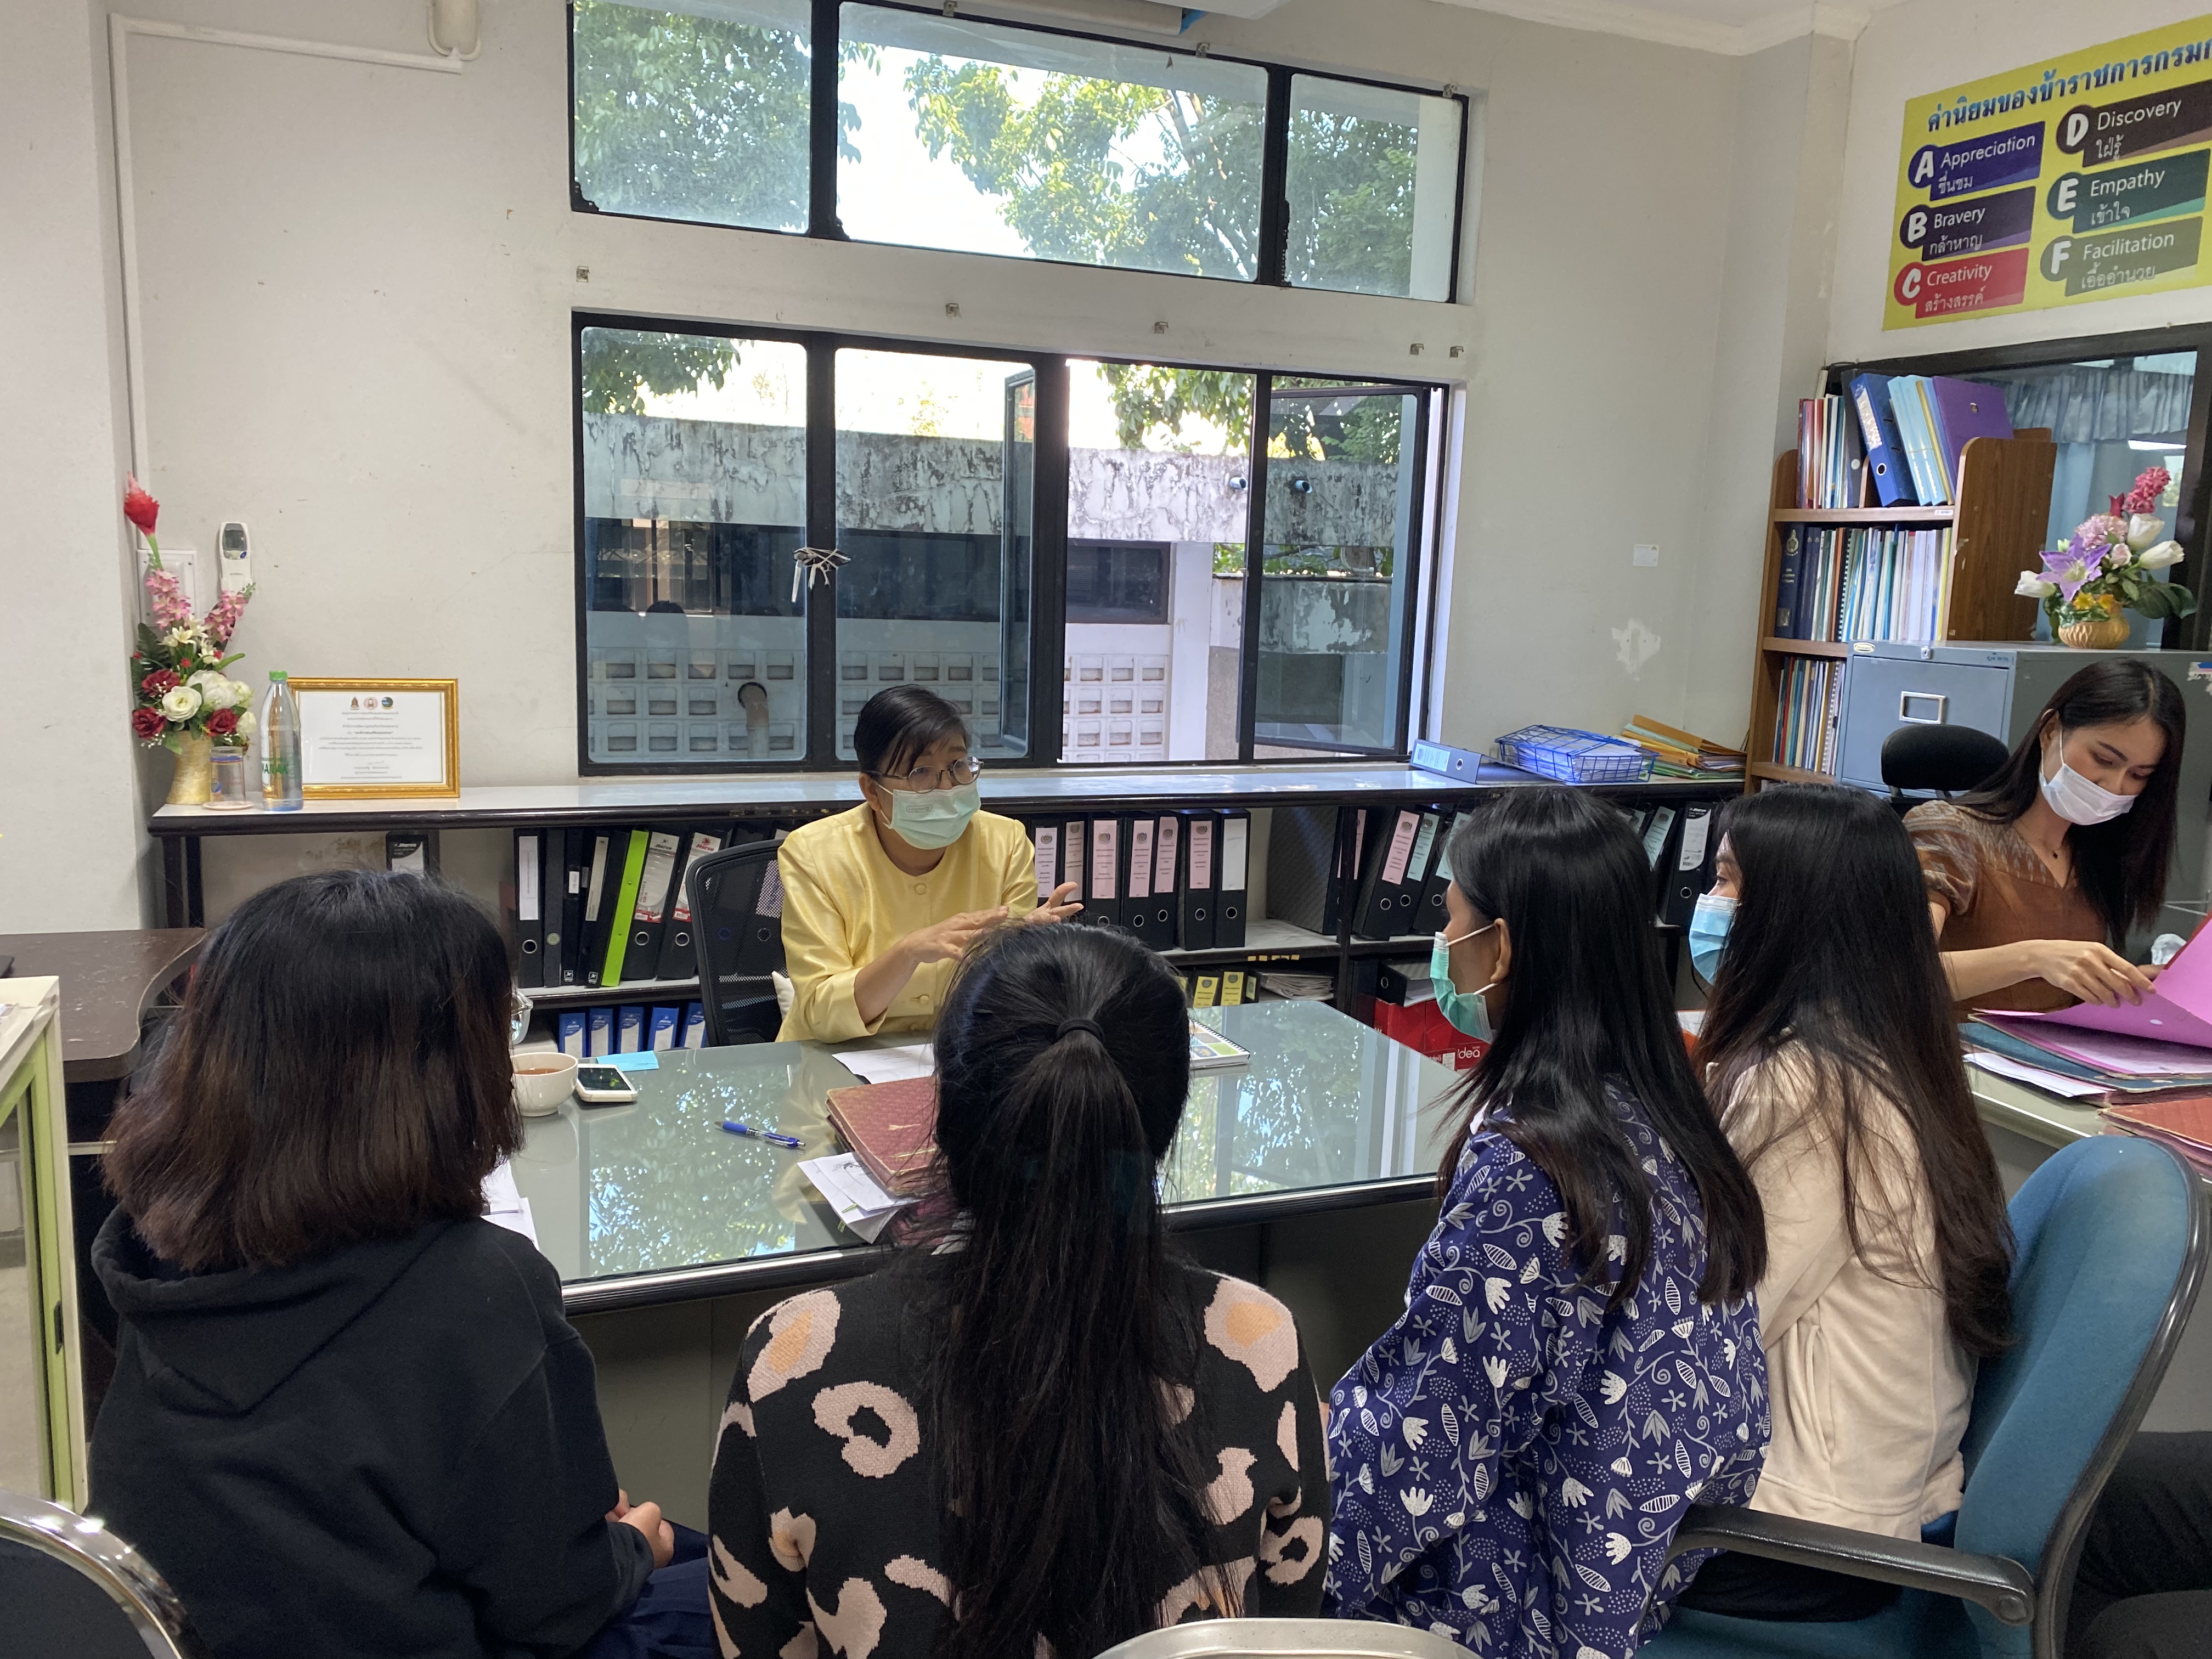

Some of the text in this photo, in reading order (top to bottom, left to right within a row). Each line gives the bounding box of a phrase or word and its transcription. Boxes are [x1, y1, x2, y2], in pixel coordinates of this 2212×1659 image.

[2067, 100, 2181, 146] D Discovery
[1915, 135, 2035, 184] A Appreciation
[2096, 134, 2124, 161] ใฝ่รู้
[1938, 171, 1973, 194] ชื่นชม
[2058, 169, 2165, 212] E Empathy
[1908, 208, 1986, 242] B Bravery
[2091, 201, 2131, 225] เข้าใจ
[1929, 234, 1983, 255] กล้าหาญ
[2051, 234, 2174, 274] F Facilitation
[1902, 263, 1992, 298] C Creativity
[2081, 262, 2155, 289] เอื้ออำนวย
[1925, 285, 1987, 312] สร้างสรรค์
